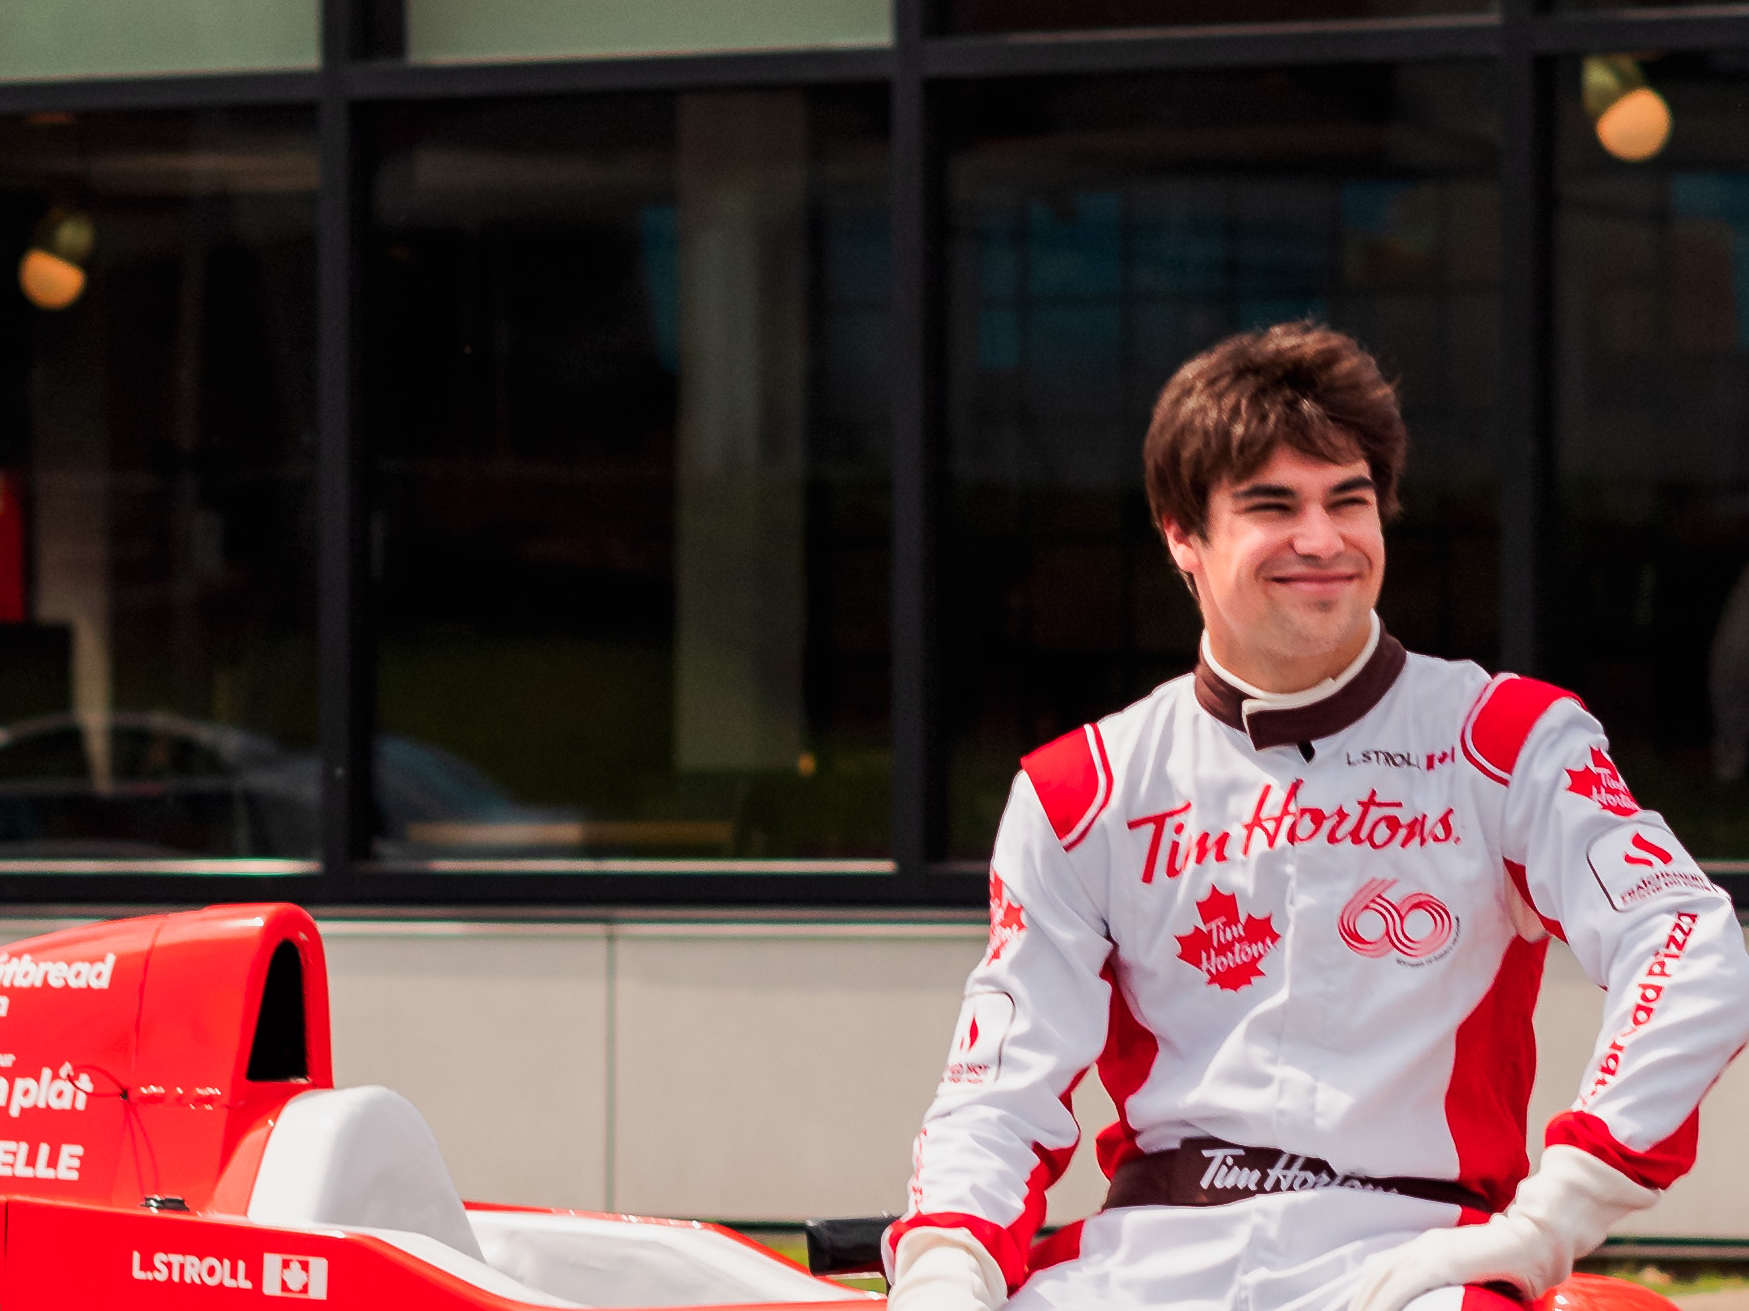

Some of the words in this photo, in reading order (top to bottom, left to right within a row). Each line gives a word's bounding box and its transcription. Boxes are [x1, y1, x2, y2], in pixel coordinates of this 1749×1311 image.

[1127, 801, 1233, 884] Tim
[1204, 915, 1245, 949] Tim
[1338, 877, 1452, 958] 60
[1200, 935, 1280, 976] Hortons
[1200, 1148, 1262, 1190] Tim
[132, 1250, 253, 1290] L.STROLL
